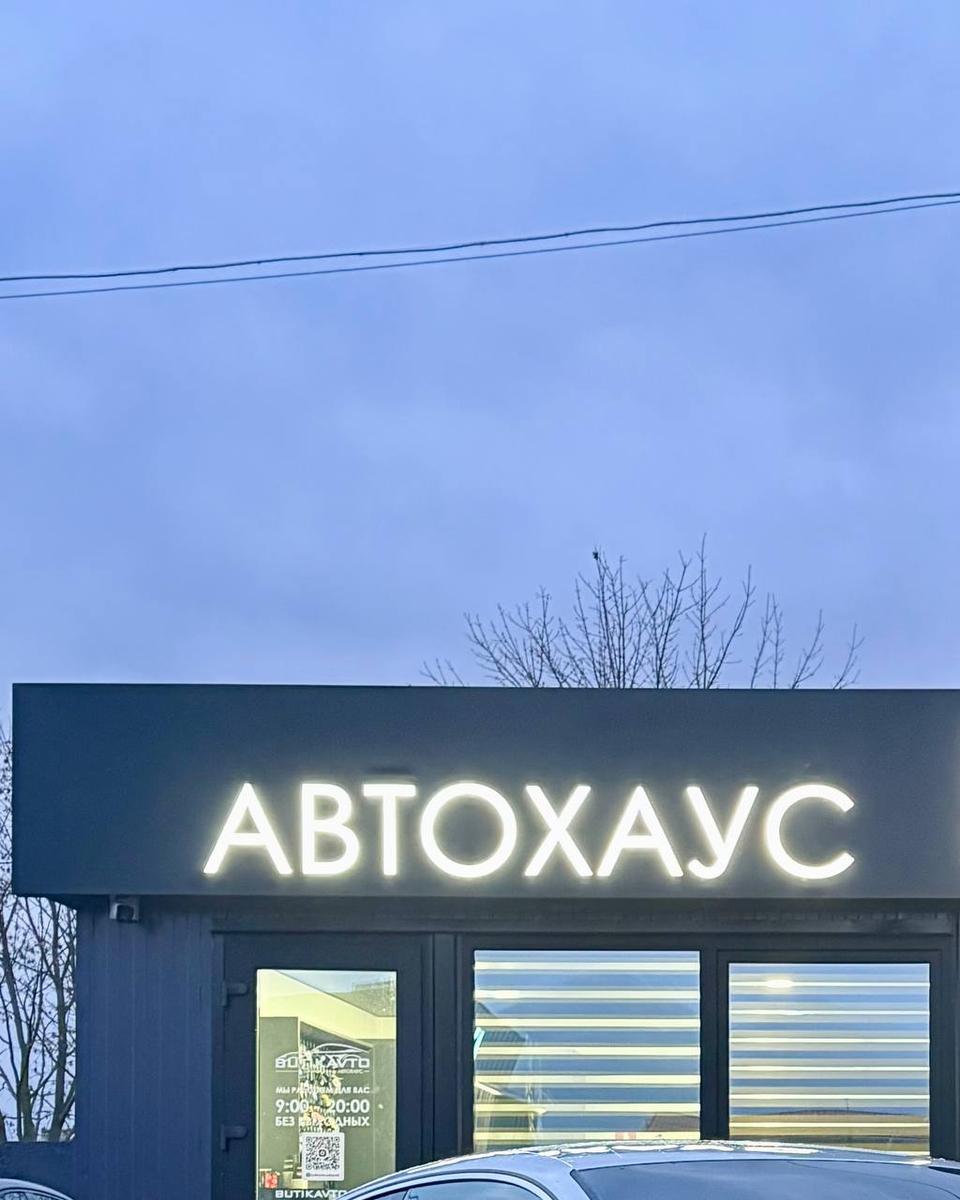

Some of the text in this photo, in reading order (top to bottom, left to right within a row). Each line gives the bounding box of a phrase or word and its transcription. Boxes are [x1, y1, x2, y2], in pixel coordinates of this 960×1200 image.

[203, 782, 855, 879] АВТОХАУС
[275, 1099, 370, 1113] 9:00 20:00
[275, 1116, 295, 1127] БЕЗ
